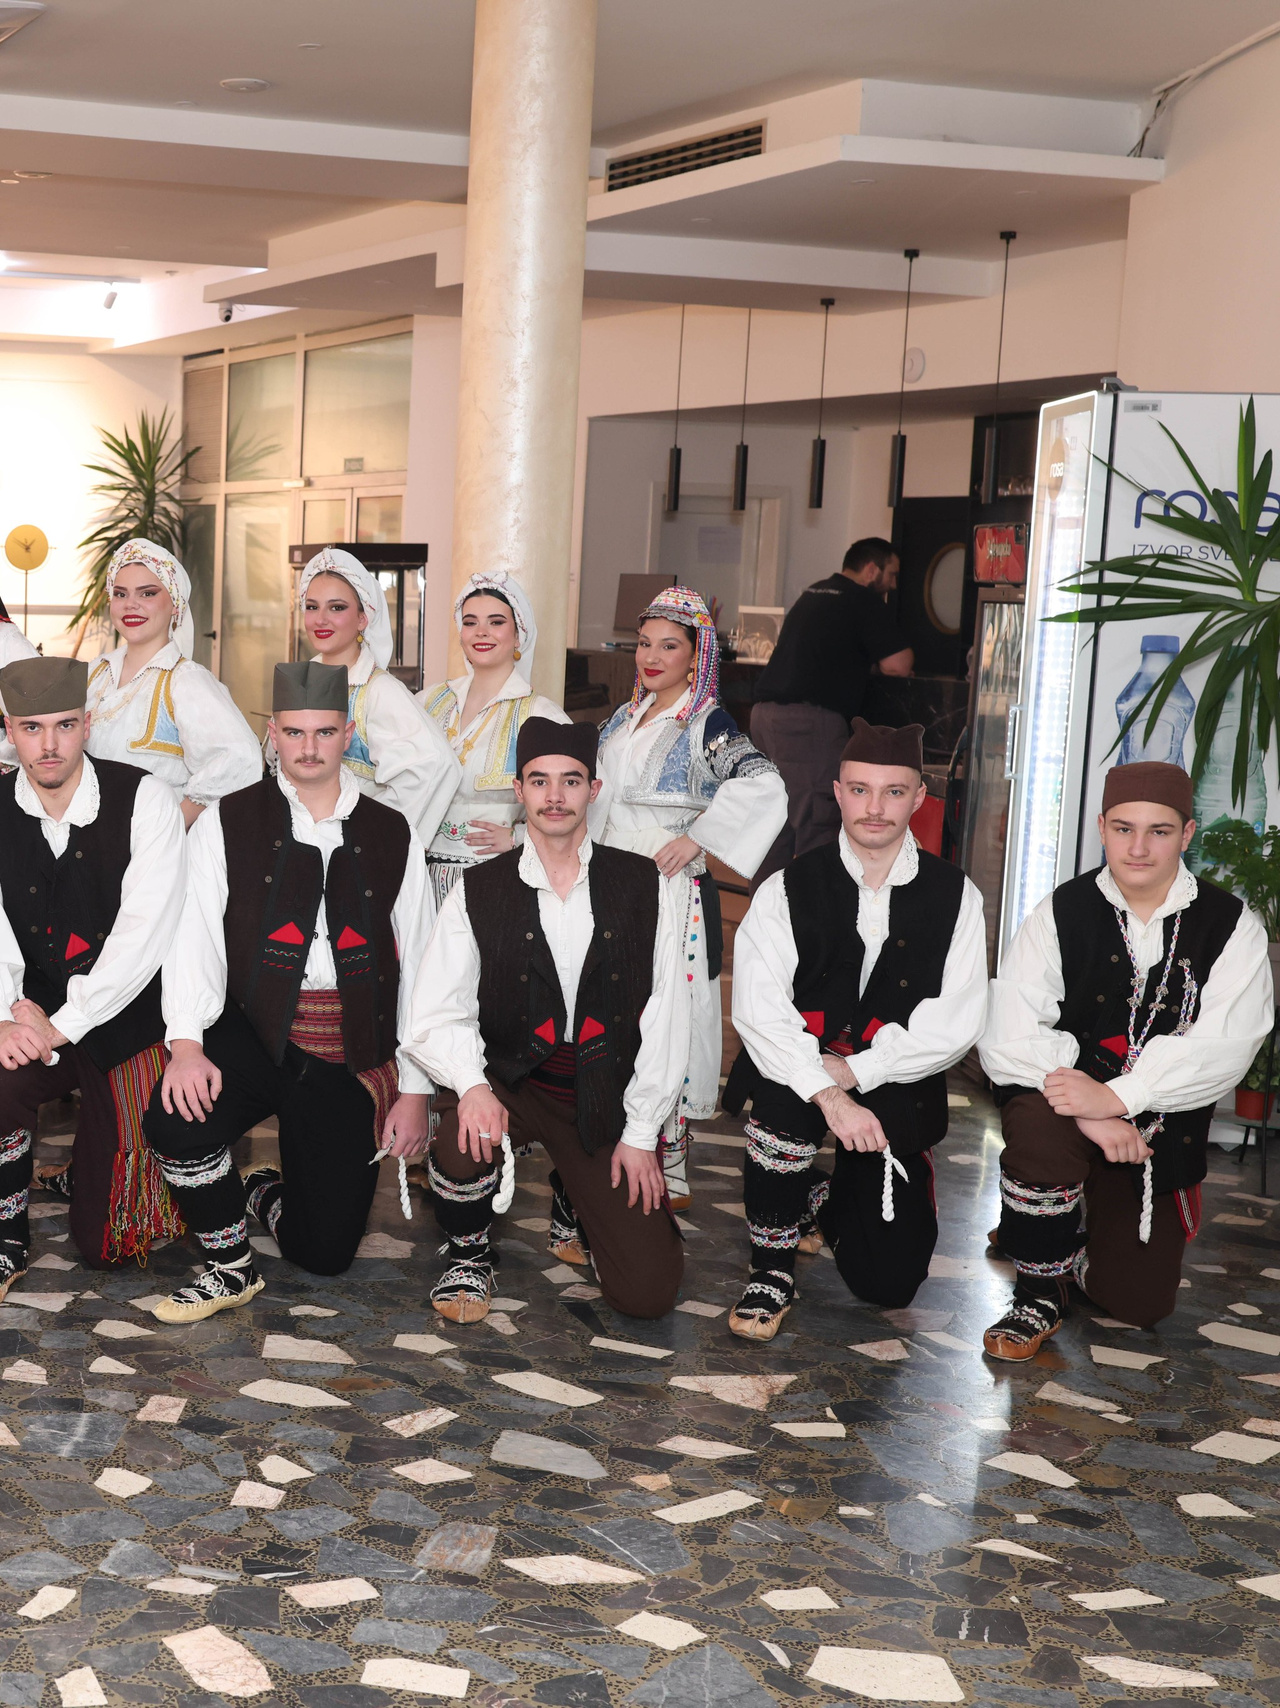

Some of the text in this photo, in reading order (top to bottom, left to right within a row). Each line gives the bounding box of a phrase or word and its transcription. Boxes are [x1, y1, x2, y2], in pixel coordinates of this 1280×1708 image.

[1050, 462, 1064, 478] rosa
[1134, 489, 1280, 533] roa
[1132, 543, 1193, 559] IZVOR
